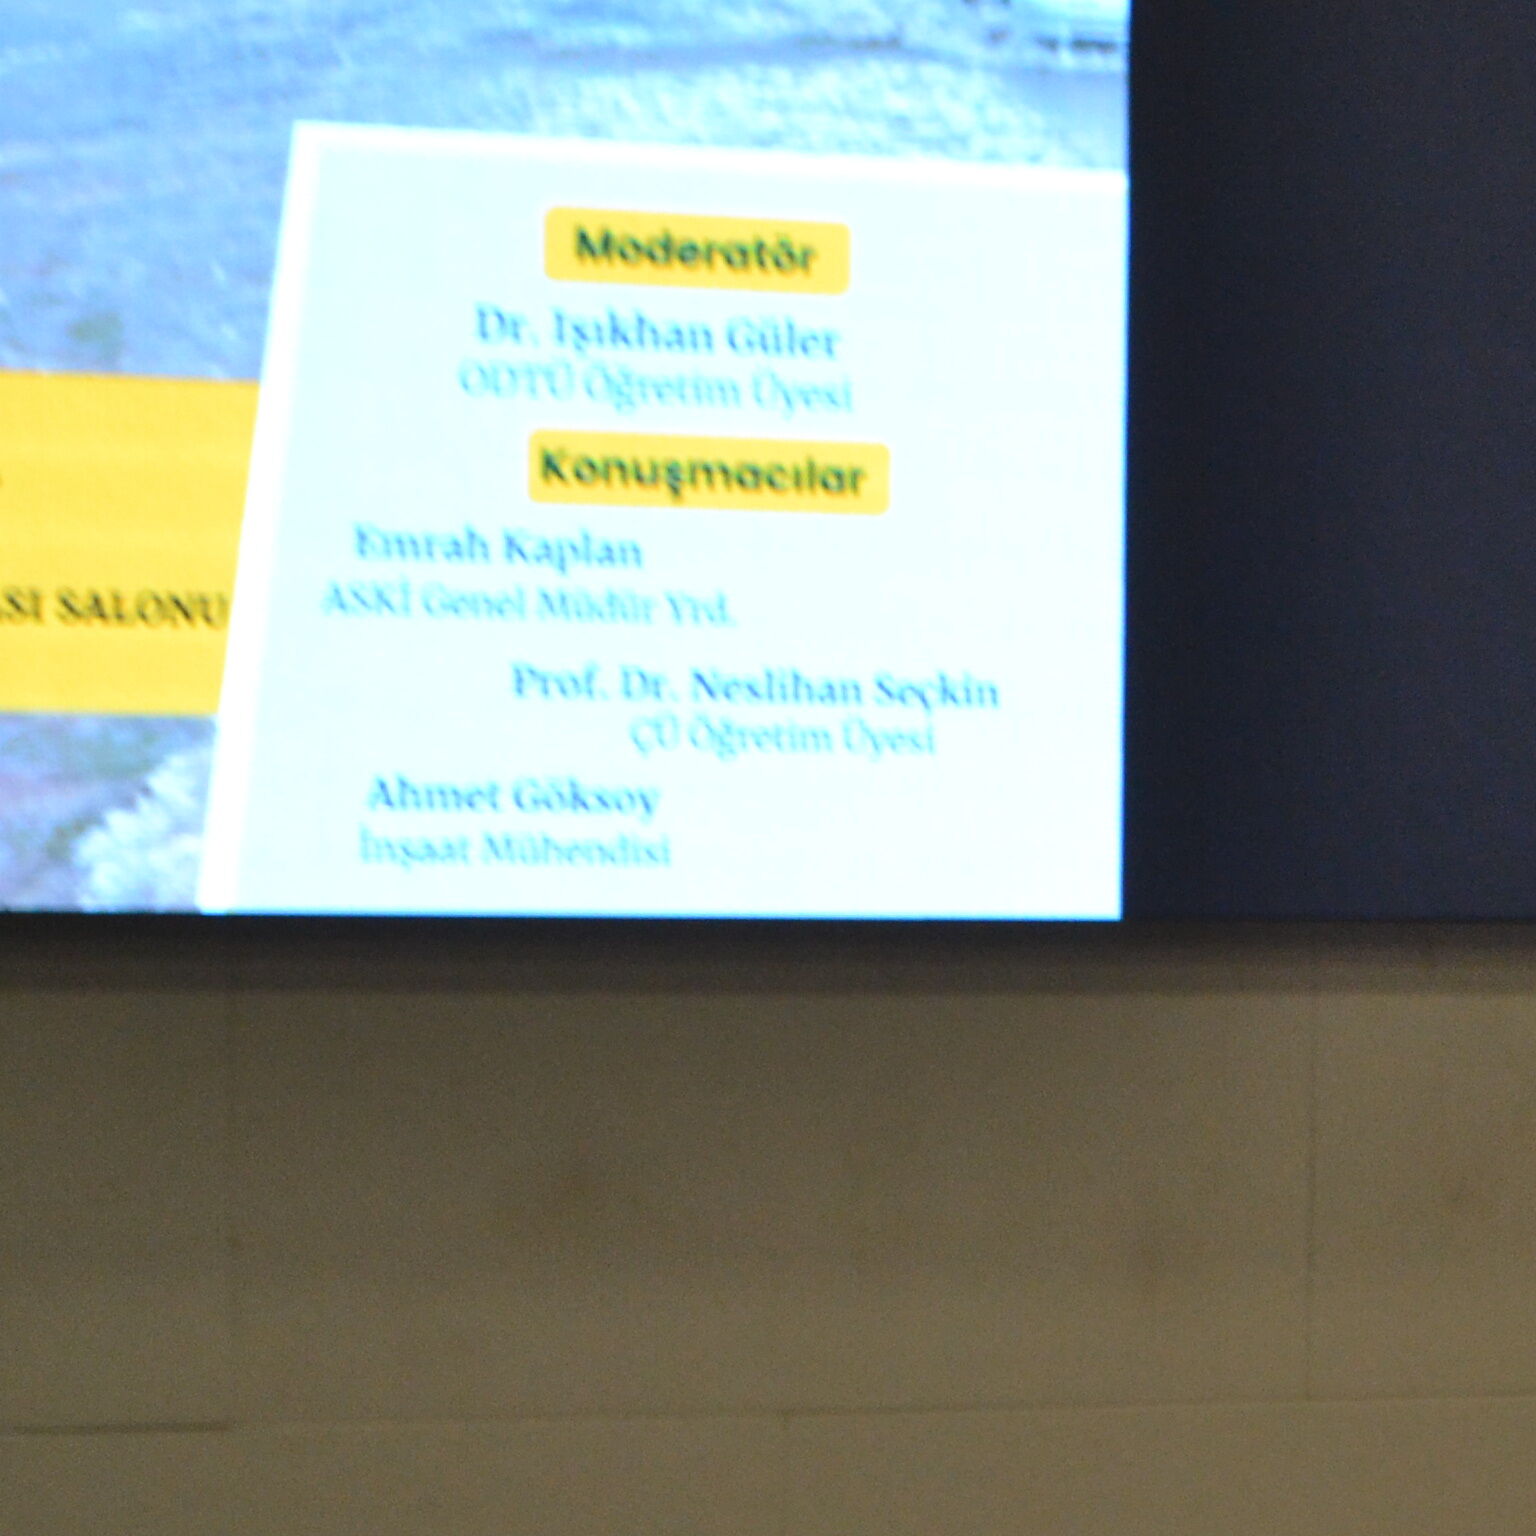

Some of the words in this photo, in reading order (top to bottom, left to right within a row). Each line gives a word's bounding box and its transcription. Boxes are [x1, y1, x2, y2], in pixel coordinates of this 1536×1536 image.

[574, 224, 818, 276] Moderatör
[473, 302, 540, 348] Dr.
[725, 315, 842, 359] Güler
[539, 447, 868, 502] Konuşmacılar
[353, 524, 490, 563] Emrah
[502, 528, 644, 574] Kaplan
[56, 587, 228, 629] SALONU
[509, 661, 607, 702] Prof.
[620, 665, 678, 703] Dr.
[690, 667, 862, 707] Neslihan
[873, 670, 1000, 714] Seçkin
[368, 773, 500, 814] Ahmet
[511, 779, 660, 822] Göksoy
